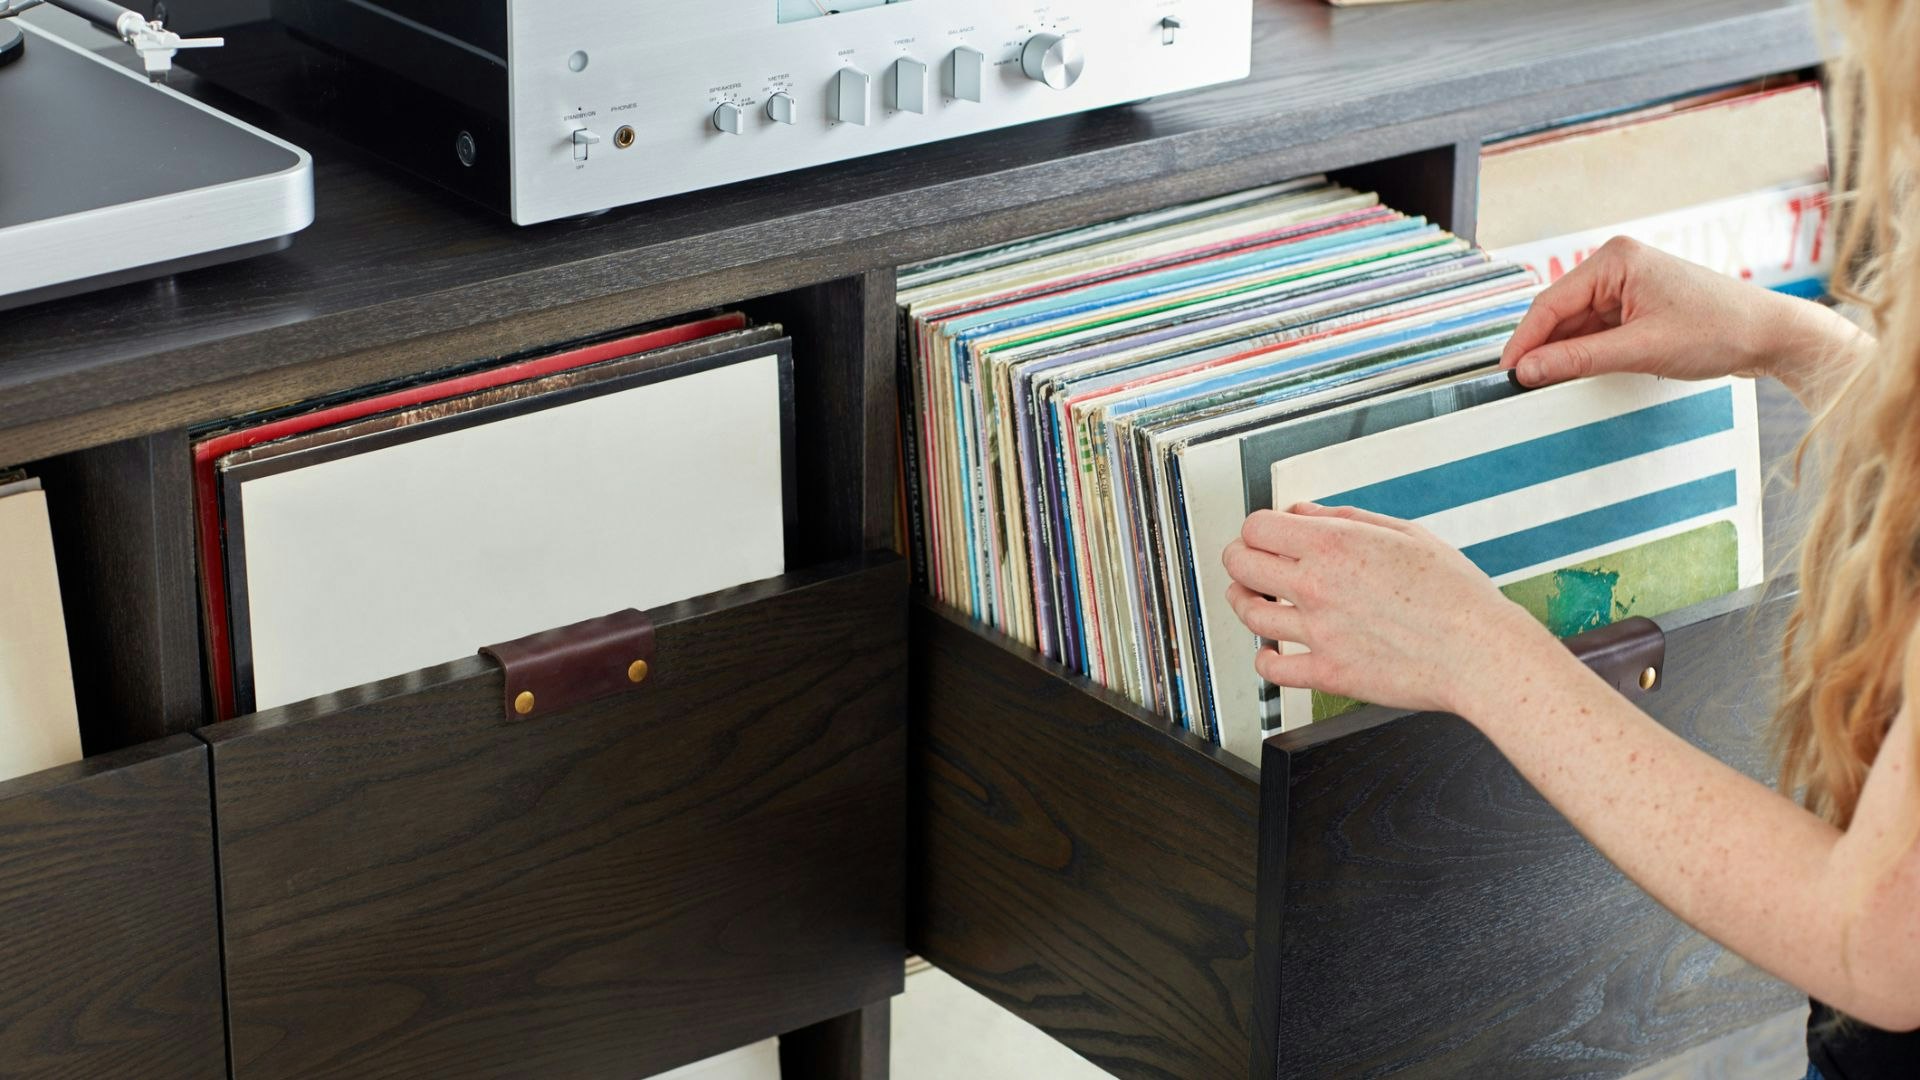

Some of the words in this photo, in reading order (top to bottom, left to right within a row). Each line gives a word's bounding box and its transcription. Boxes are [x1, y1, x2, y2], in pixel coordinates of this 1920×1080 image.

[948, 26, 975, 35] BALANCE
[894, 37, 915, 46] TREBLE
[838, 48, 855, 56] BASS
[768, 74, 789, 82] METER
[709, 83, 742, 93] SPEAKERS
[610, 102, 637, 112] PHONES
[564, 111, 596, 121] STANDBY/ON
